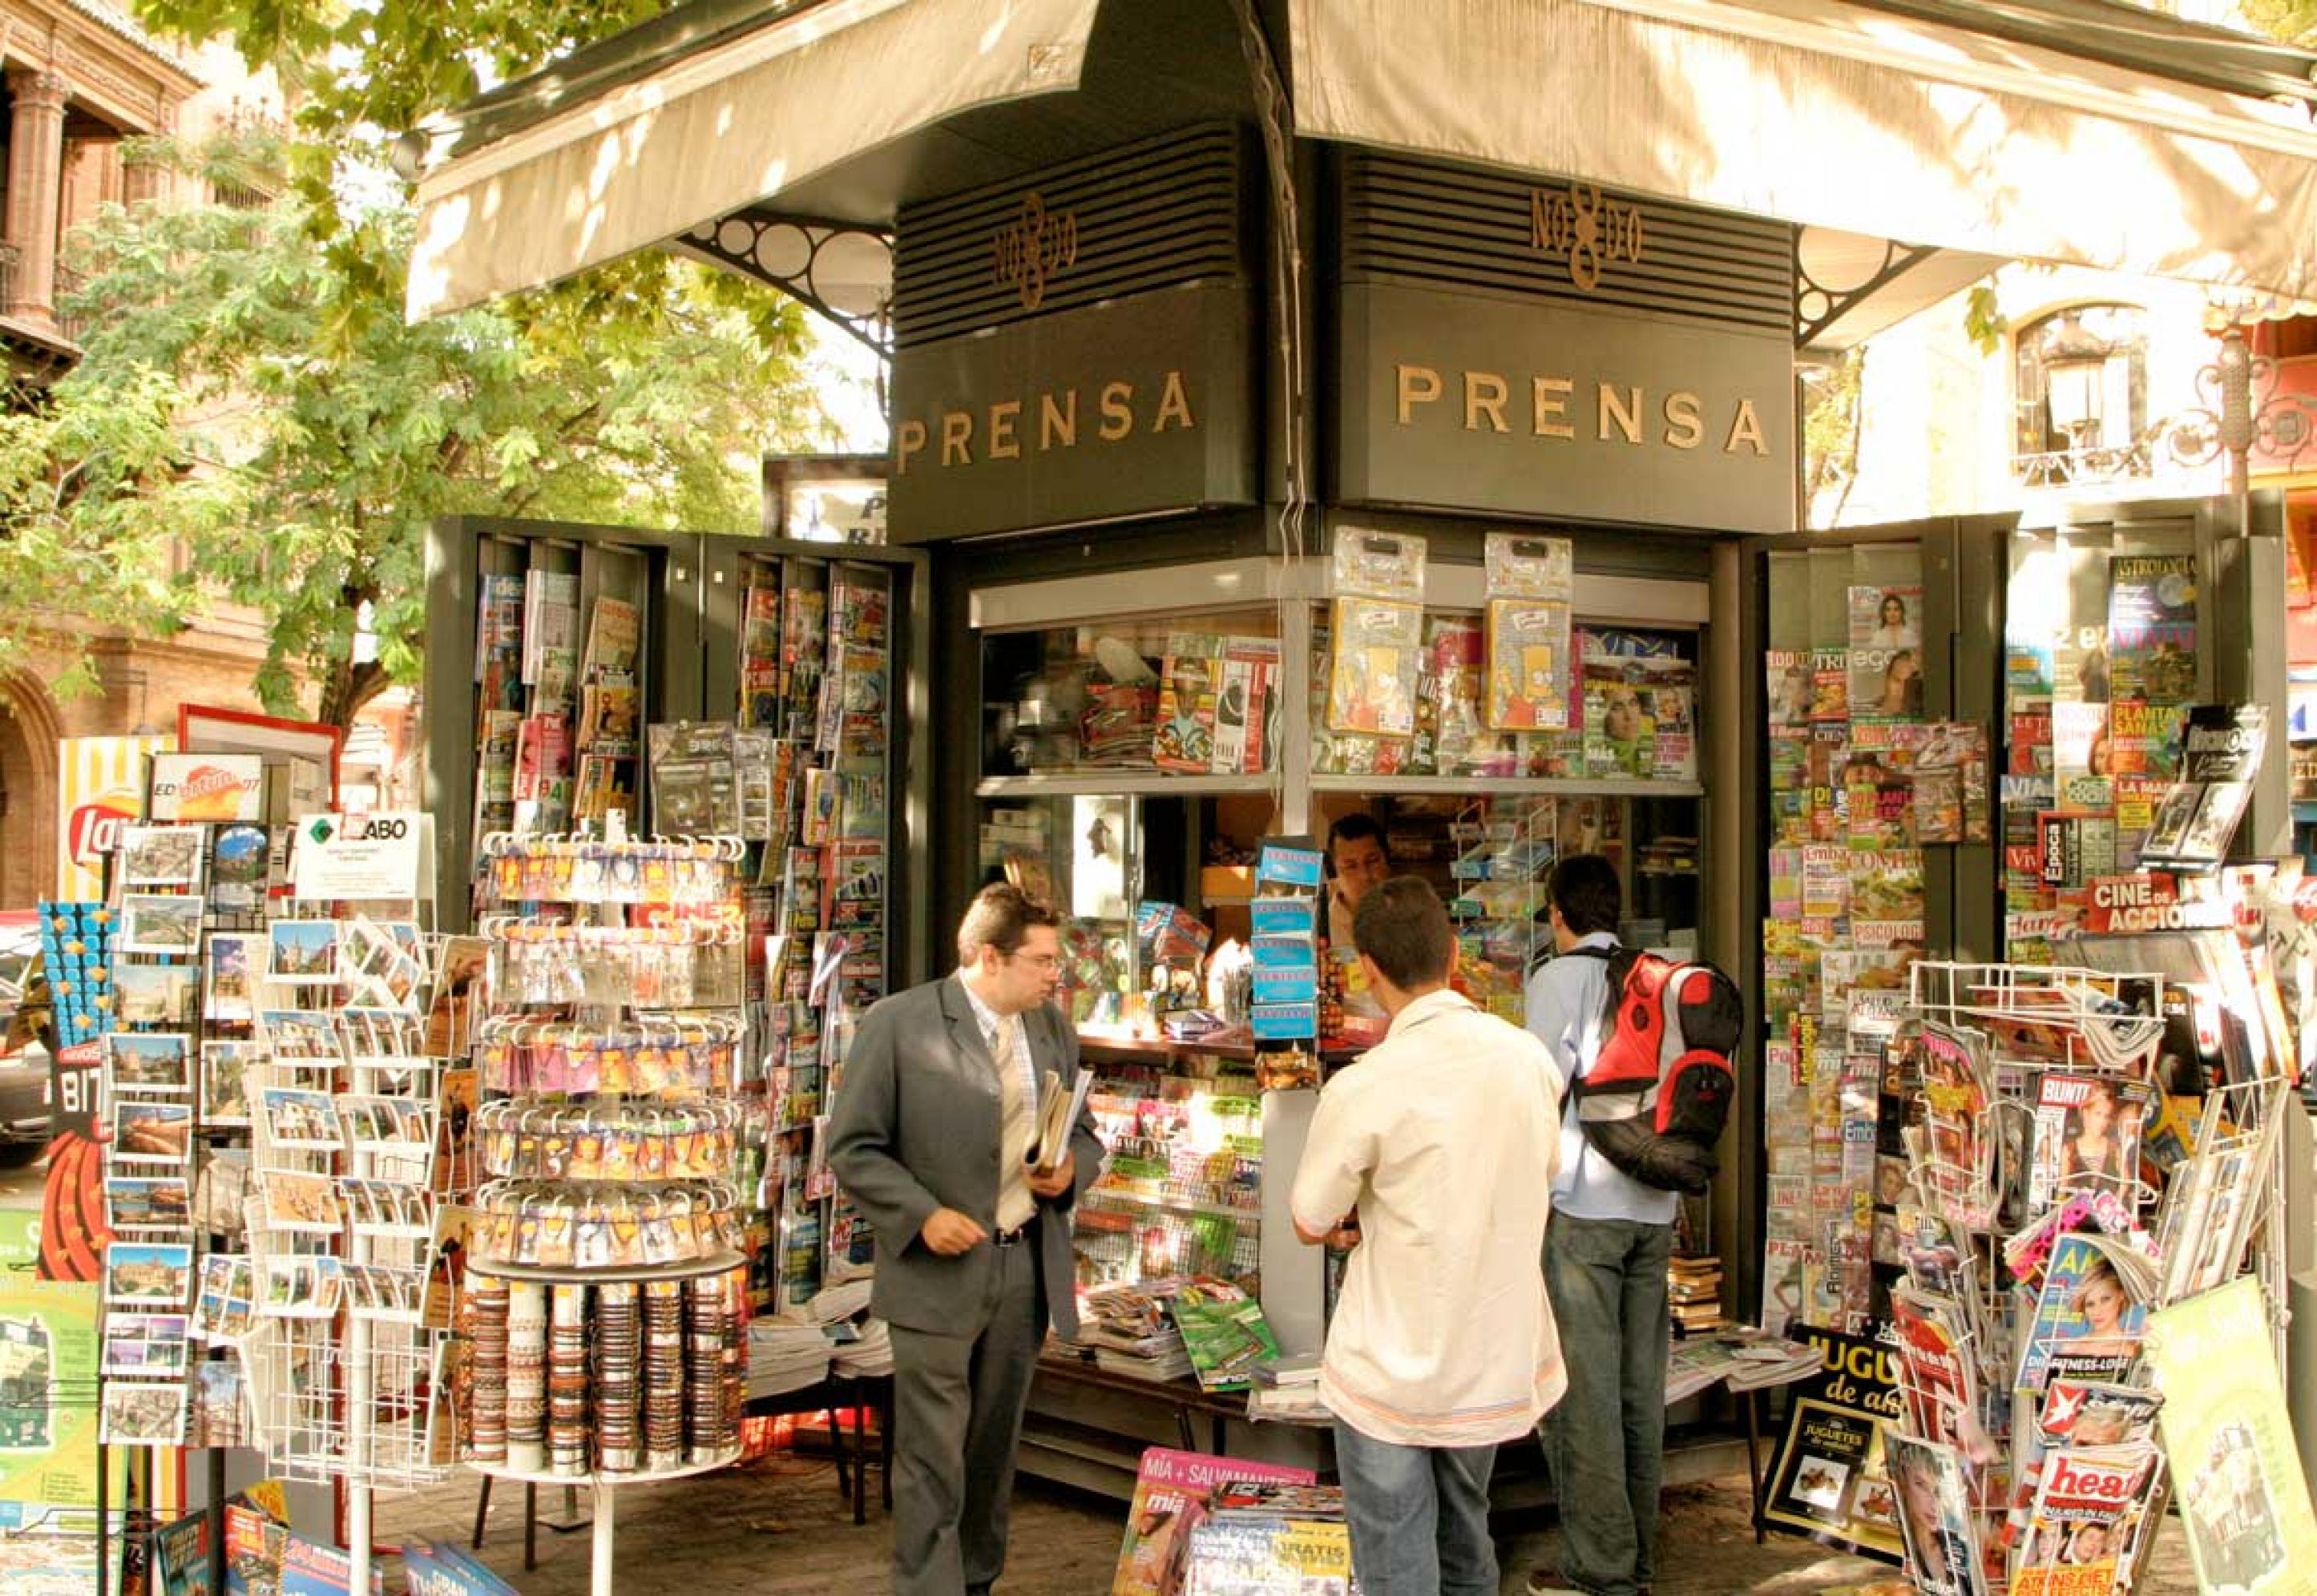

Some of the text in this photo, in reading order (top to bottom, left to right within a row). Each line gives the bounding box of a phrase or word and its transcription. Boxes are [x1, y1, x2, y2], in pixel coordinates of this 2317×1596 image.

[896, 371, 1195, 476] PRENSA
[1396, 364, 1770, 456] PRENSA
[76, 808, 122, 865] La
[365, 819, 407, 840] ABO
[2095, 883, 2151, 908] CINE
[2109, 899, 2186, 931] ACCIÓ
[1809, 1336, 1897, 1384] UGU
[1826, 1373, 1857, 1403] de
